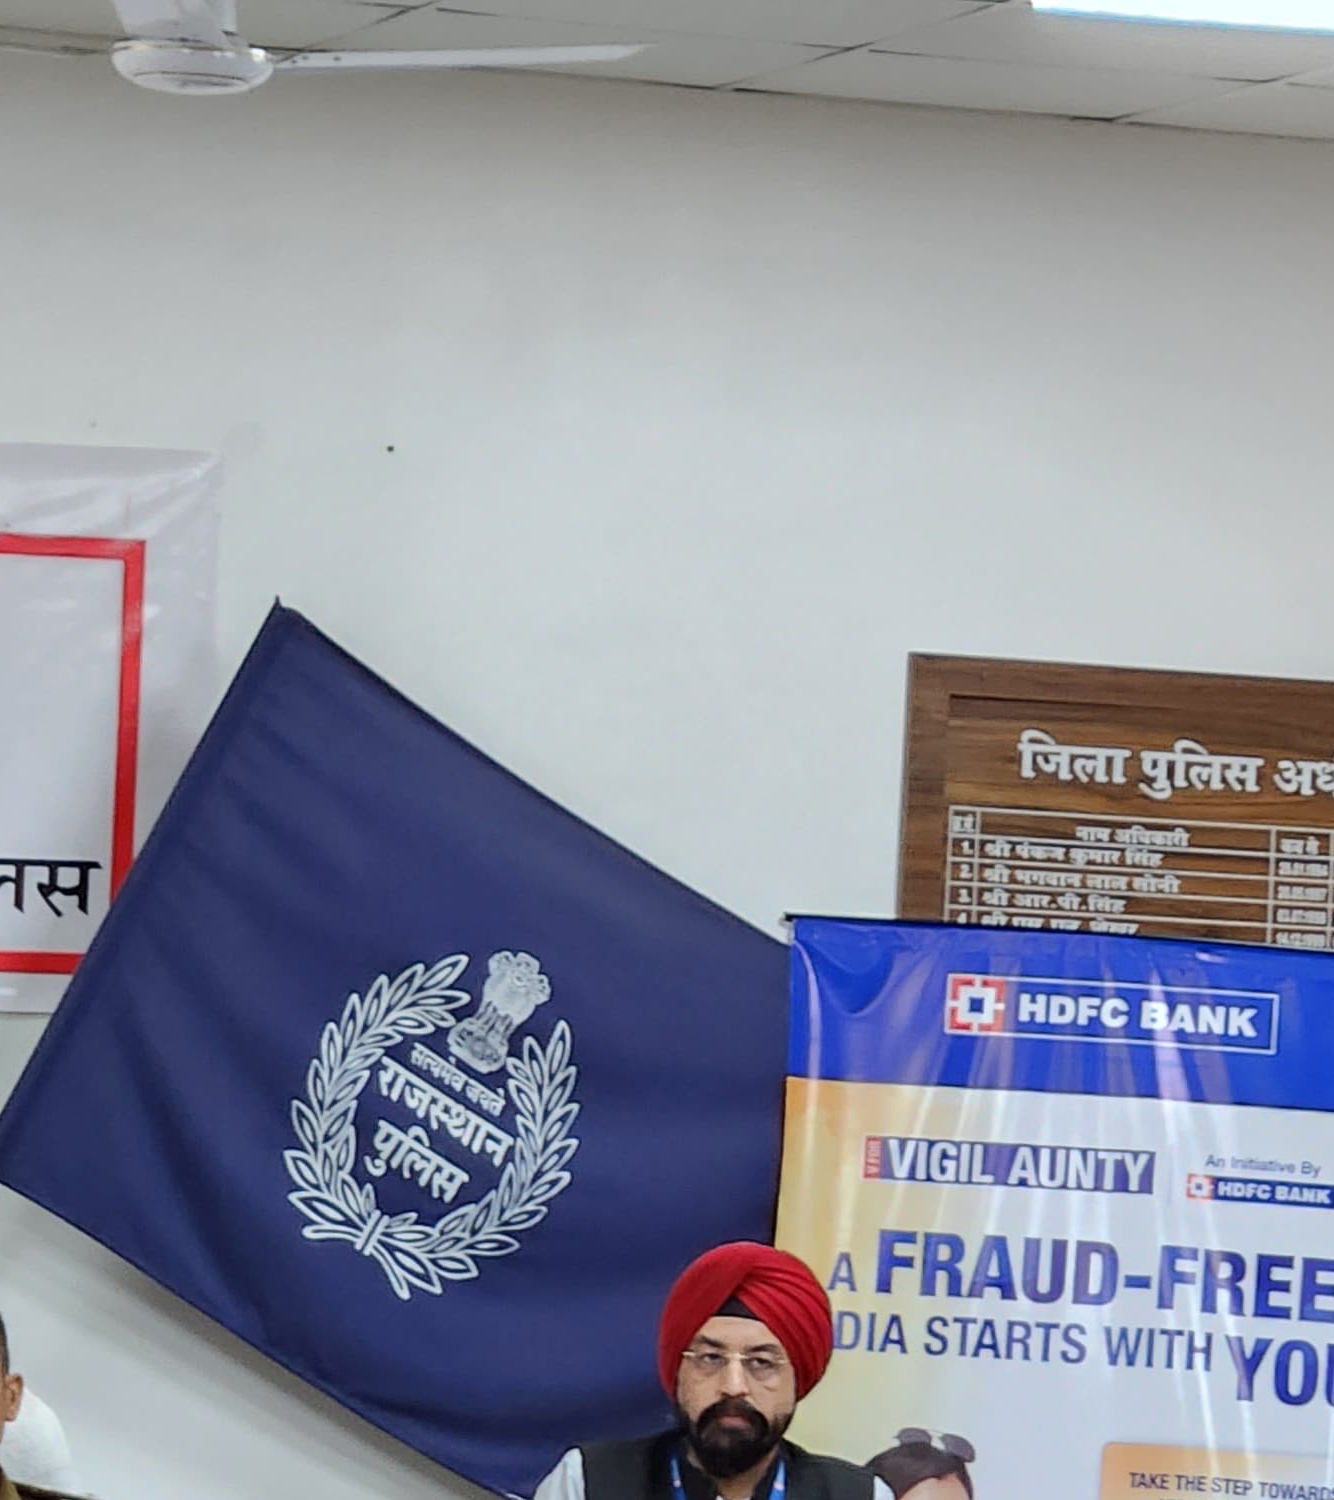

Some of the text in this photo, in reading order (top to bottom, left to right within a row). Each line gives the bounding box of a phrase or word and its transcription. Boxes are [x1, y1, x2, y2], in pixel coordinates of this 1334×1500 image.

[1018, 729, 1131, 784] जिला
[1138, 739, 1264, 800] पुलिस
[1018, 992, 1259, 1038] HDFC BANK
[379, 1056, 514, 1167] राजस्थान
[364, 1119, 470, 1203] पुलिस
[888, 1138, 994, 1184] VIGIL
[1007, 1147, 1152, 1194] AUNTY
[1204, 1154, 1322, 1178] An Initiative By
[1217, 1181, 1332, 1206] HDFC BANK
[827, 1251, 858, 1292] A
[923, 1314, 1087, 1365] STARTS
[1104, 1325, 1213, 1372] WITH
[1129, 1472, 1170, 1490] TAKE
[1174, 1474, 1207, 1493] THE
[1211, 1476, 1253, 1496] STEP
